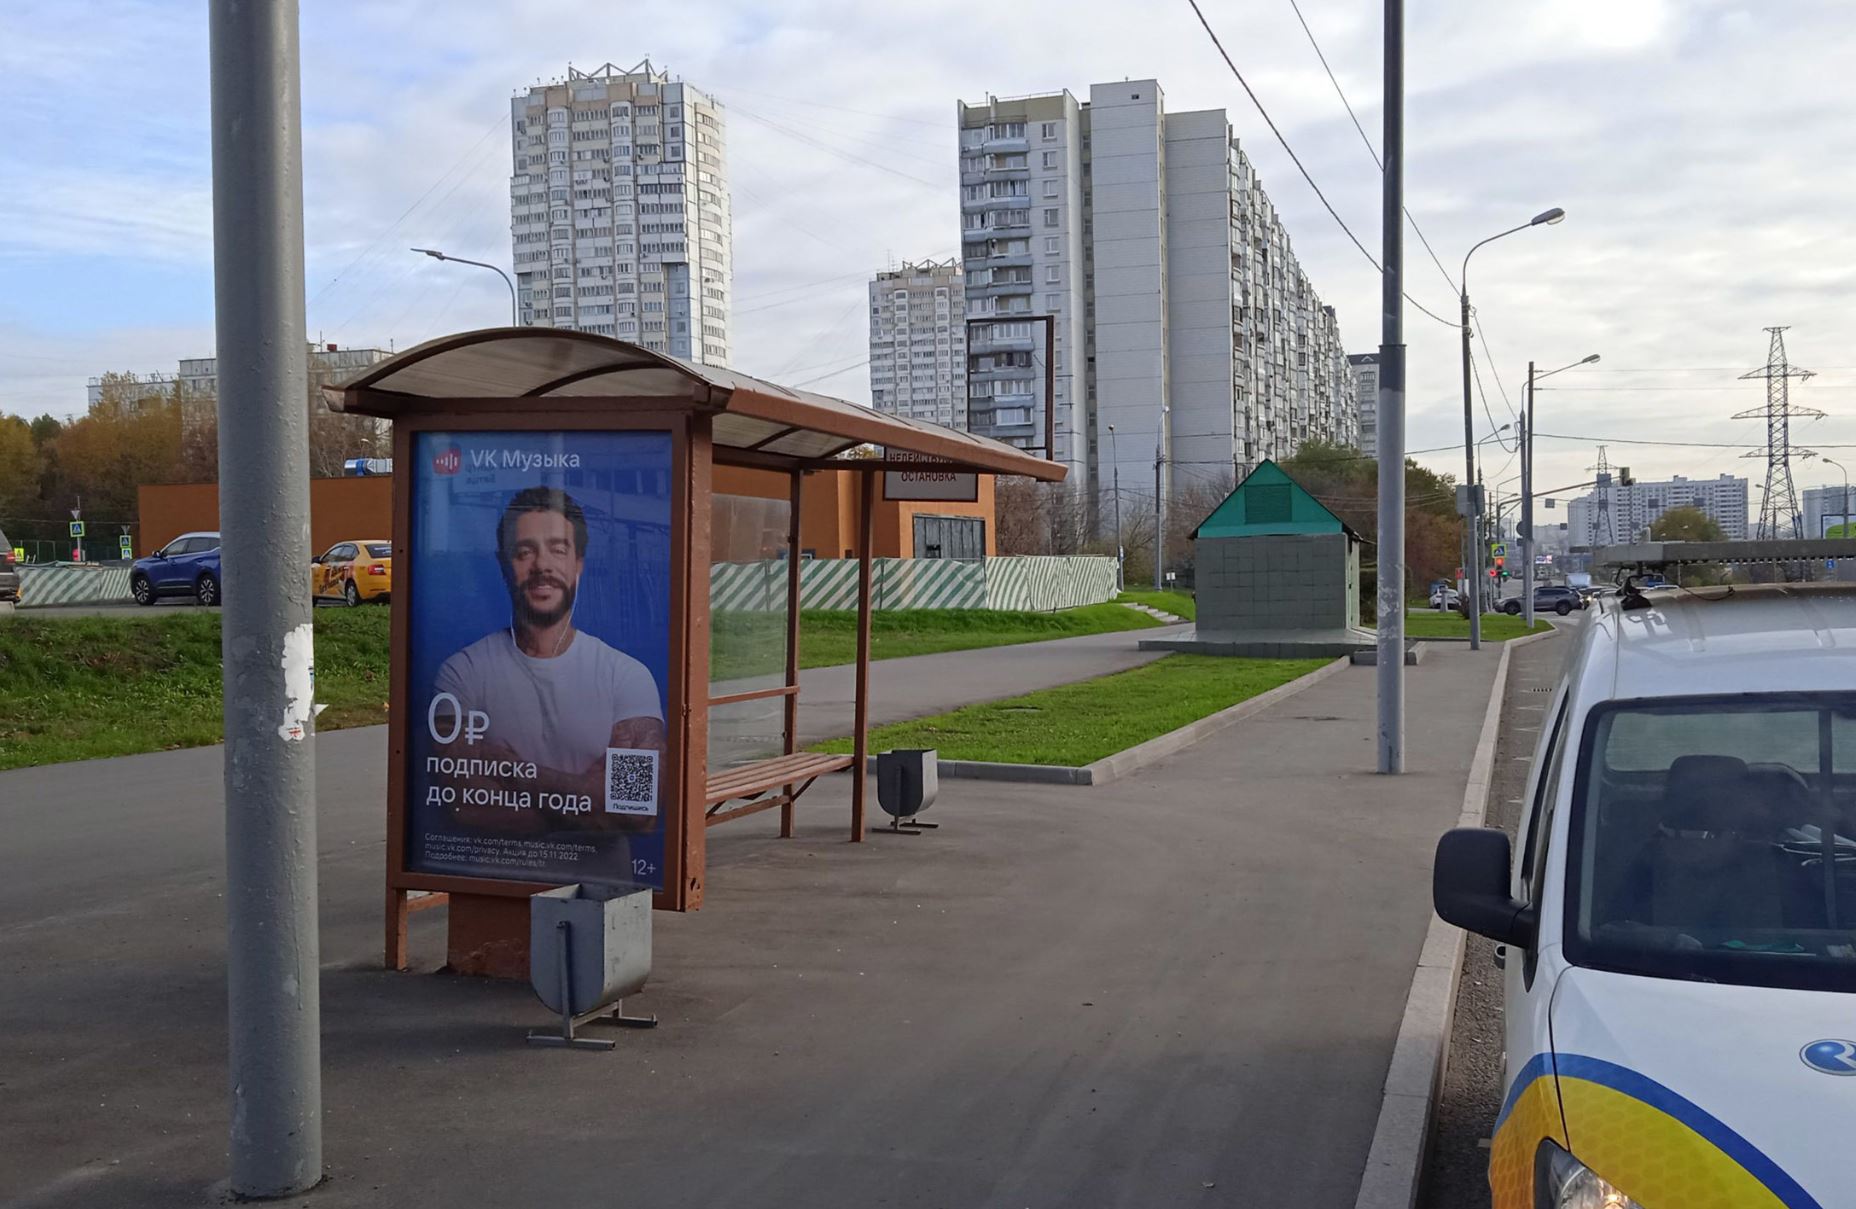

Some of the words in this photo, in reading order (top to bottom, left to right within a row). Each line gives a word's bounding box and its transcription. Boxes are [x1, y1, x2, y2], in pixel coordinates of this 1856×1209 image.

[470, 450, 497, 468] VK
[502, 450, 580, 472] Музыка
[901, 471, 957, 482] ОСТАНОВКА
[426, 756, 537, 779] подписка
[426, 786, 456, 805] до
[462, 789, 531, 811] конца
[538, 793, 592, 815] года
[632, 859, 656, 876] 12+
